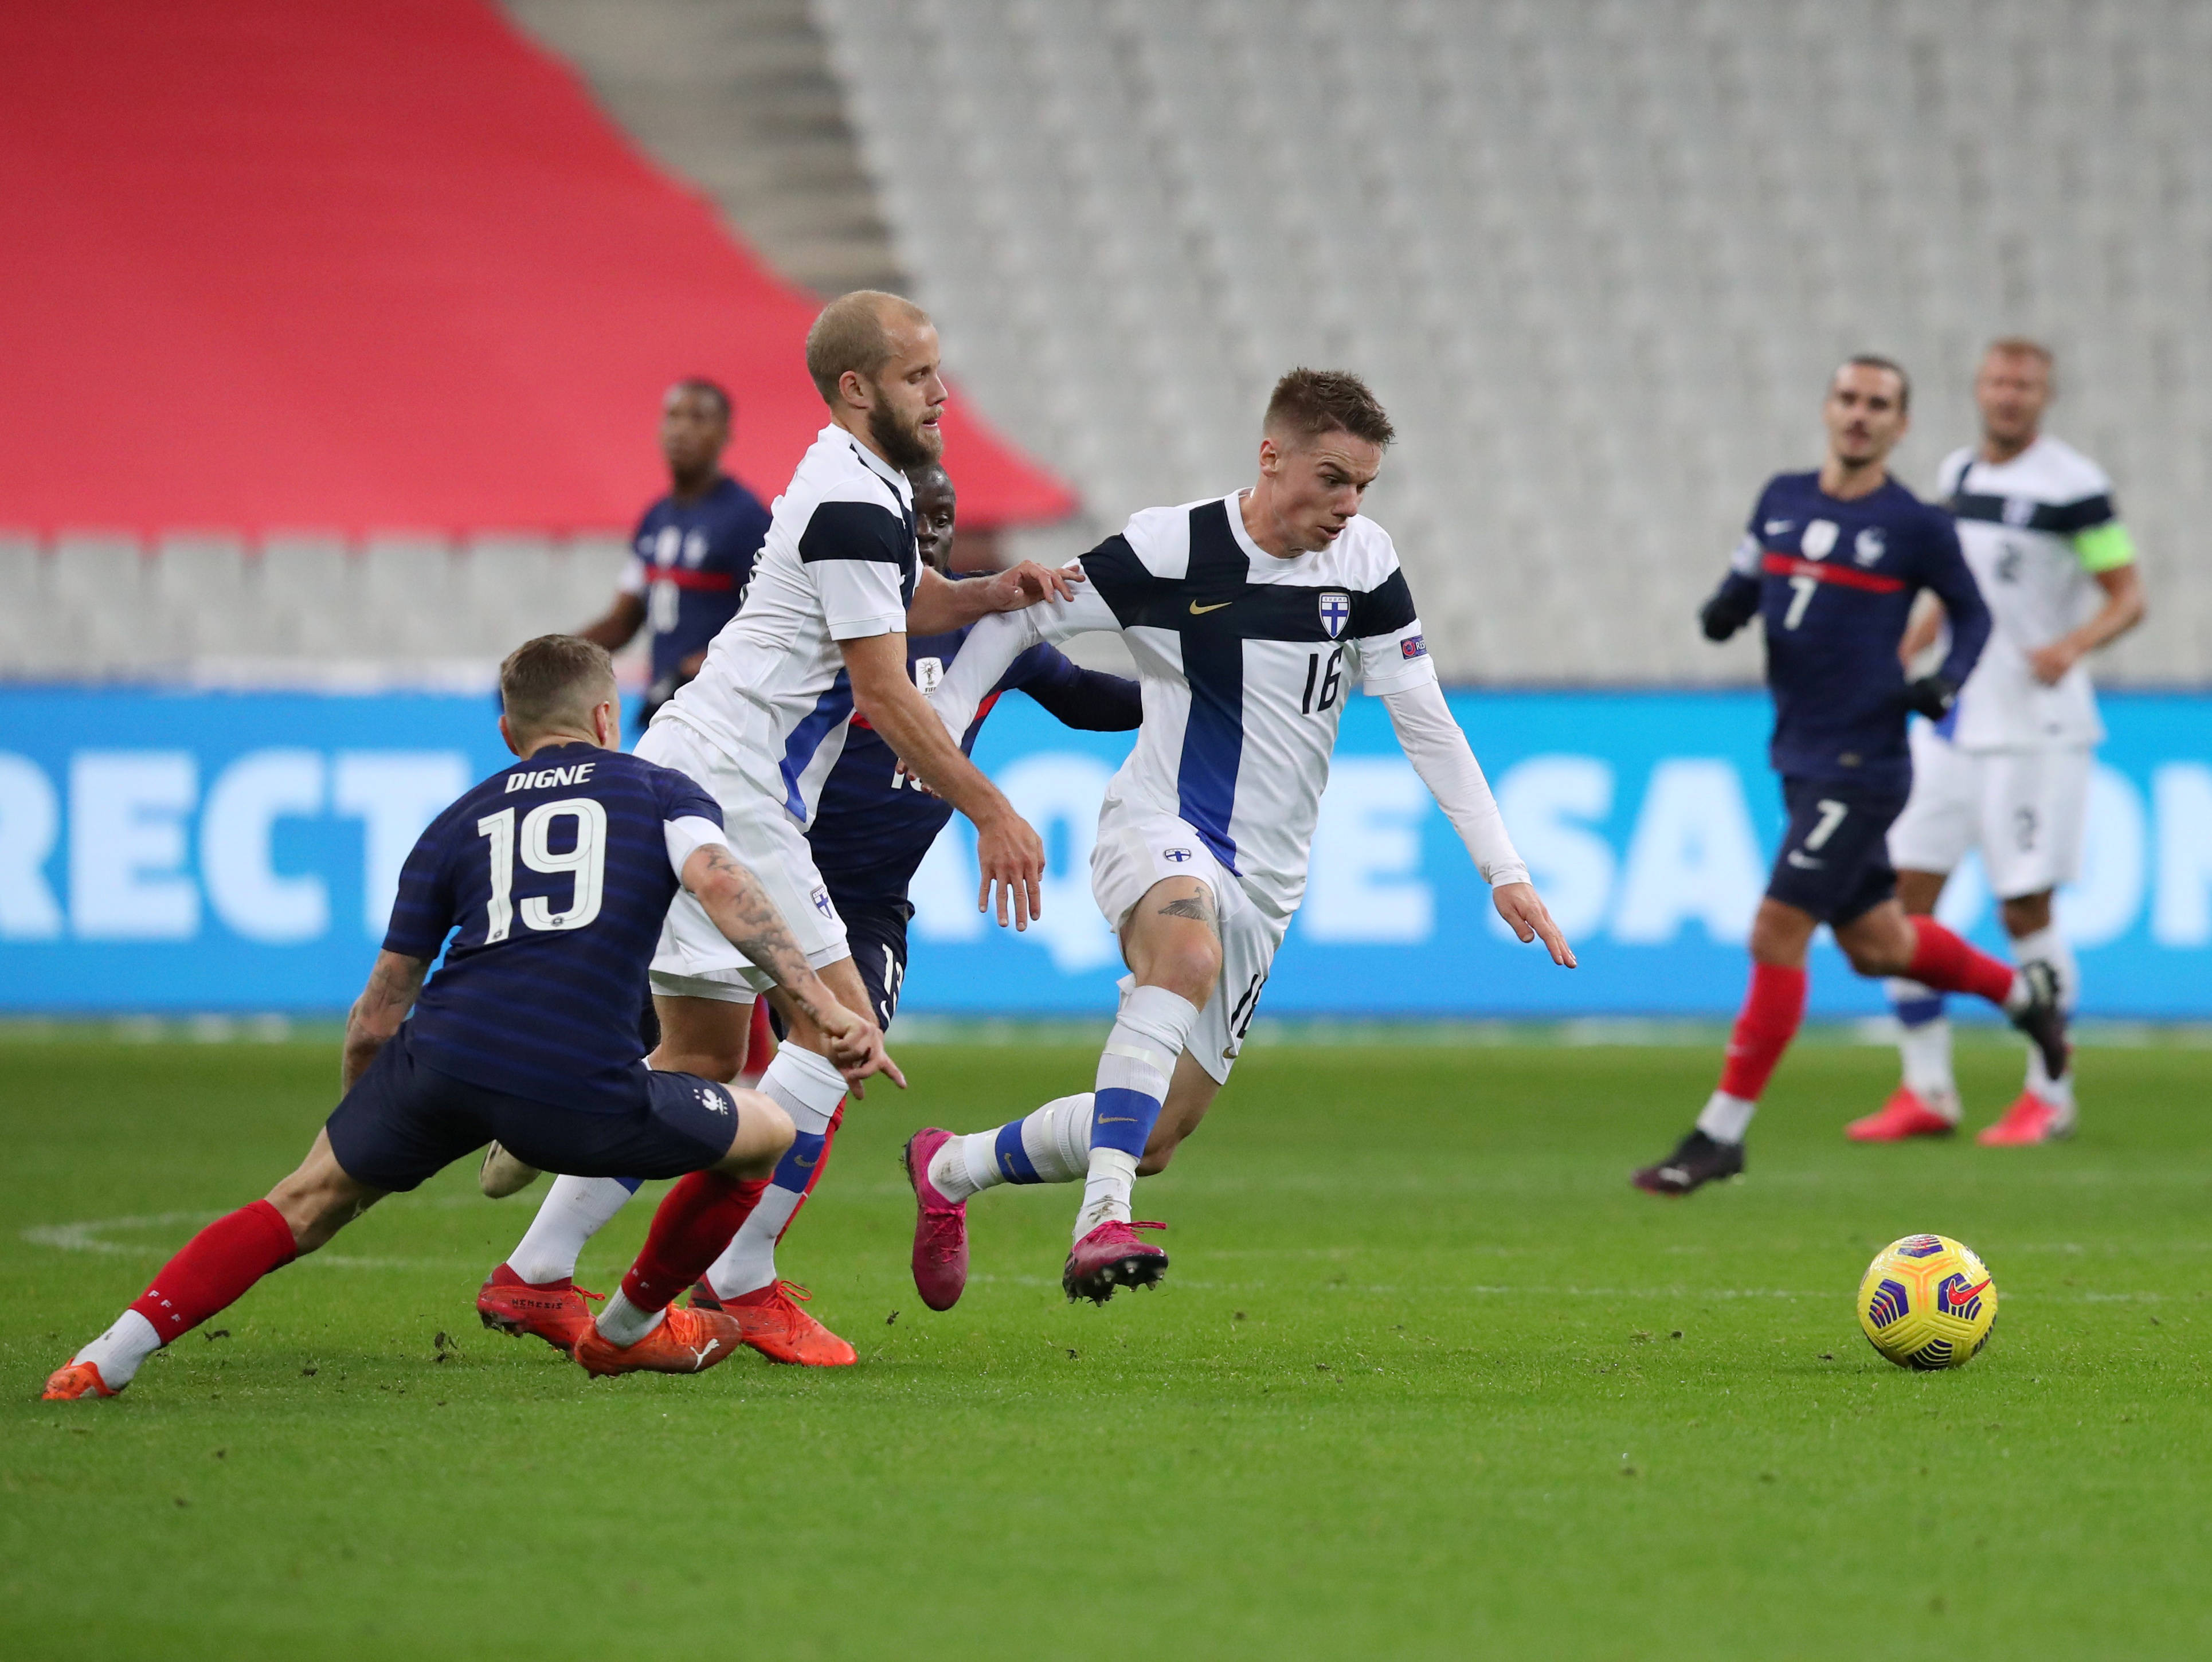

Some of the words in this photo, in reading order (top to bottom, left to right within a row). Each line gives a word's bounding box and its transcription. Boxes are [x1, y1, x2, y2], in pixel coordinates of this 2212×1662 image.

[1784, 576, 1816, 630] 7
[1302, 646, 1344, 715] 16
[504, 763, 596, 794] DIGNE
[1805, 799, 1847, 850] 7
[477, 798, 607, 945] 19
